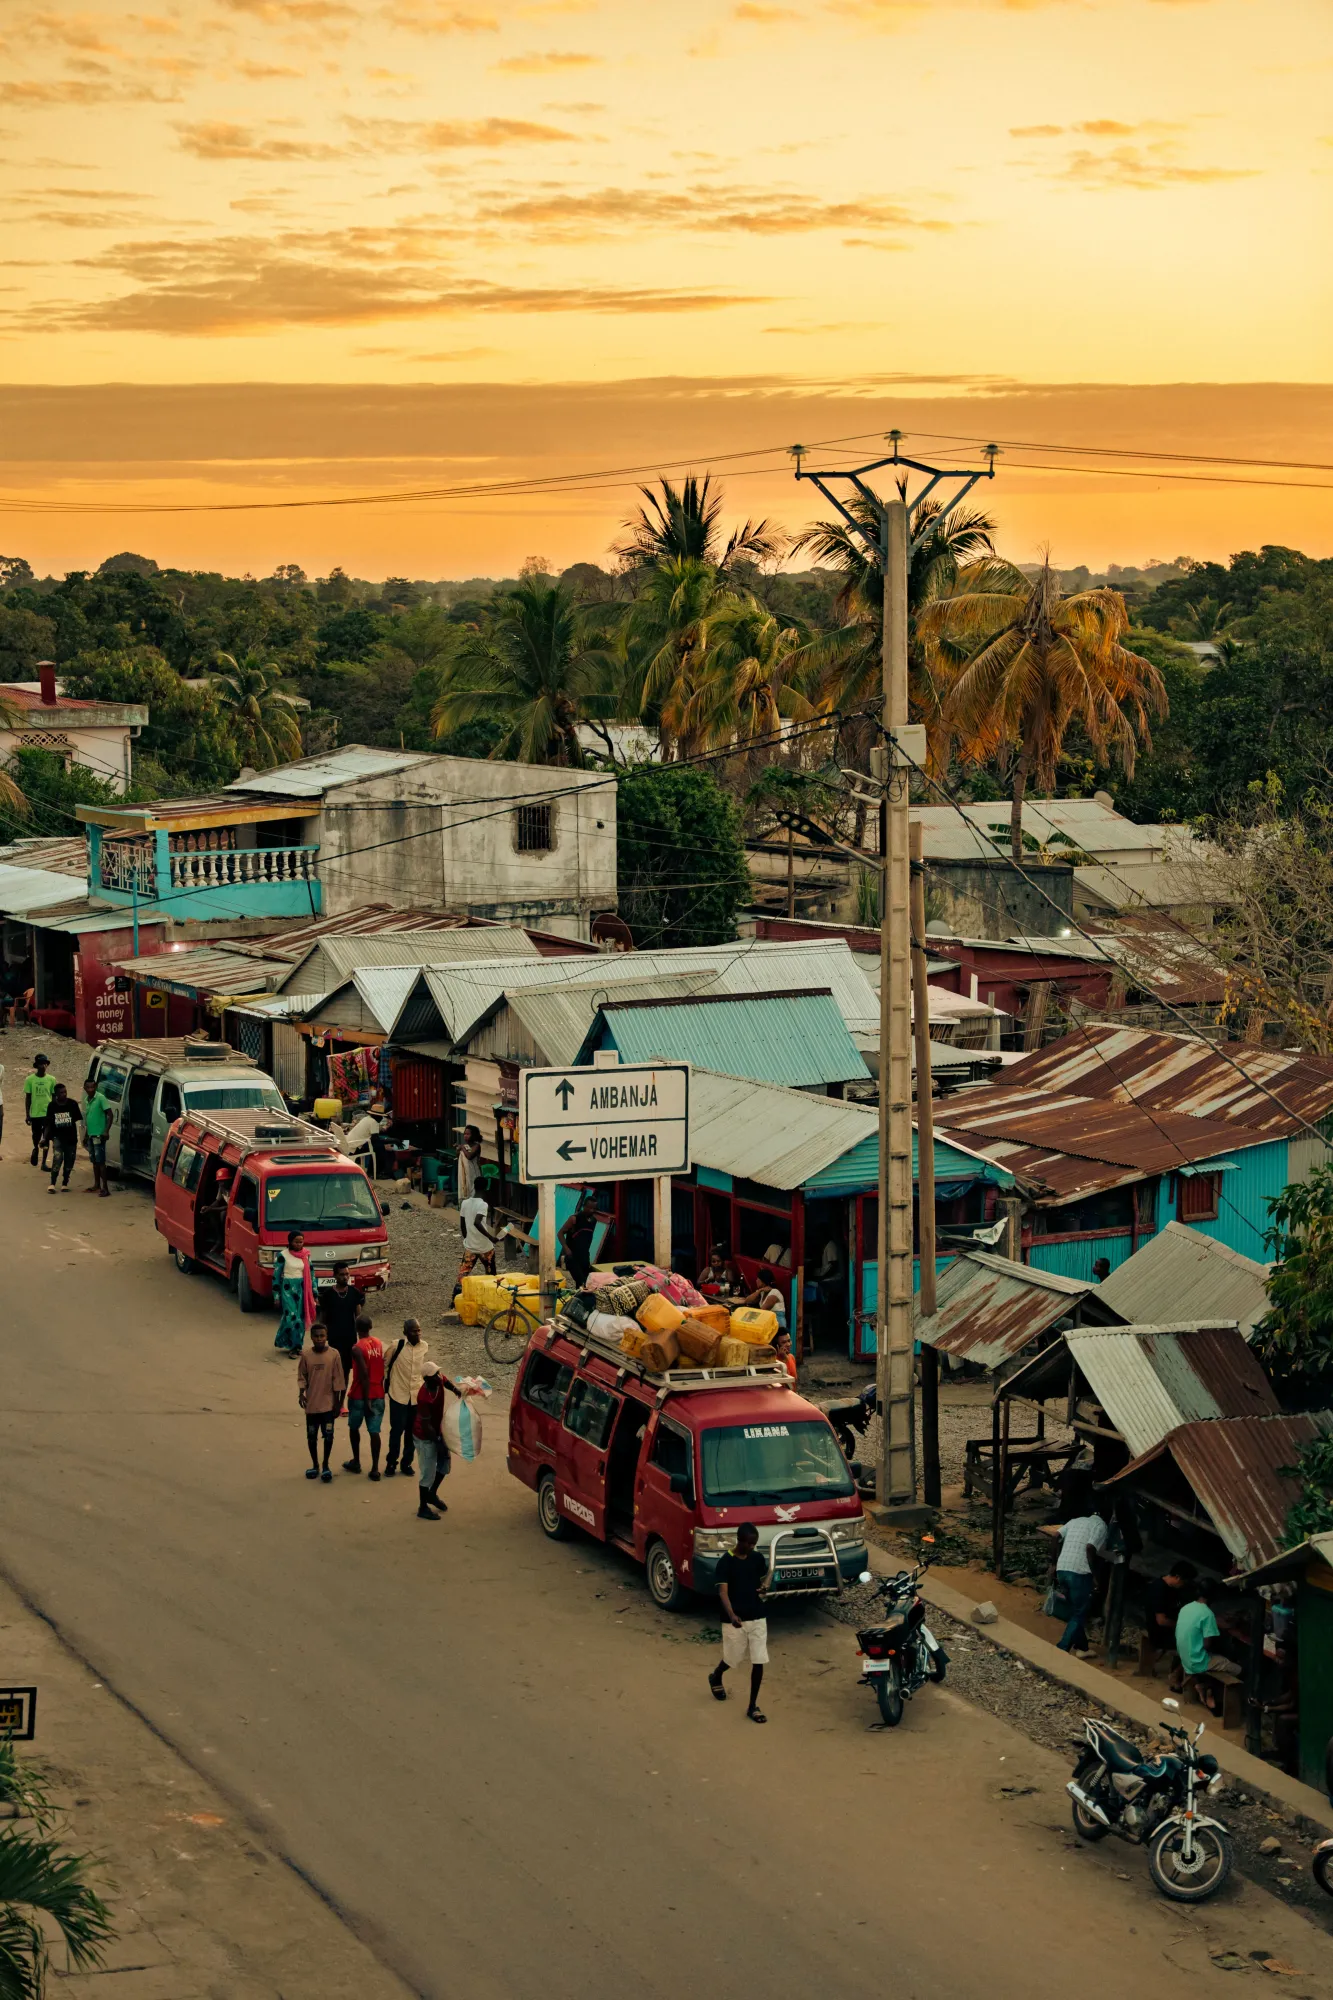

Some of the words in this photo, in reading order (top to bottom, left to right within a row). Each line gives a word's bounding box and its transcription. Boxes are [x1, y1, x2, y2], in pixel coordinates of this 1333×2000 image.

[95, 992, 130, 1007] airtel
[96, 1008, 124, 1020] money
[590, 1084, 658, 1110] AMBANJA
[590, 1134, 658, 1160] VOHEMAR
[743, 1425, 790, 1439] LIKANA
